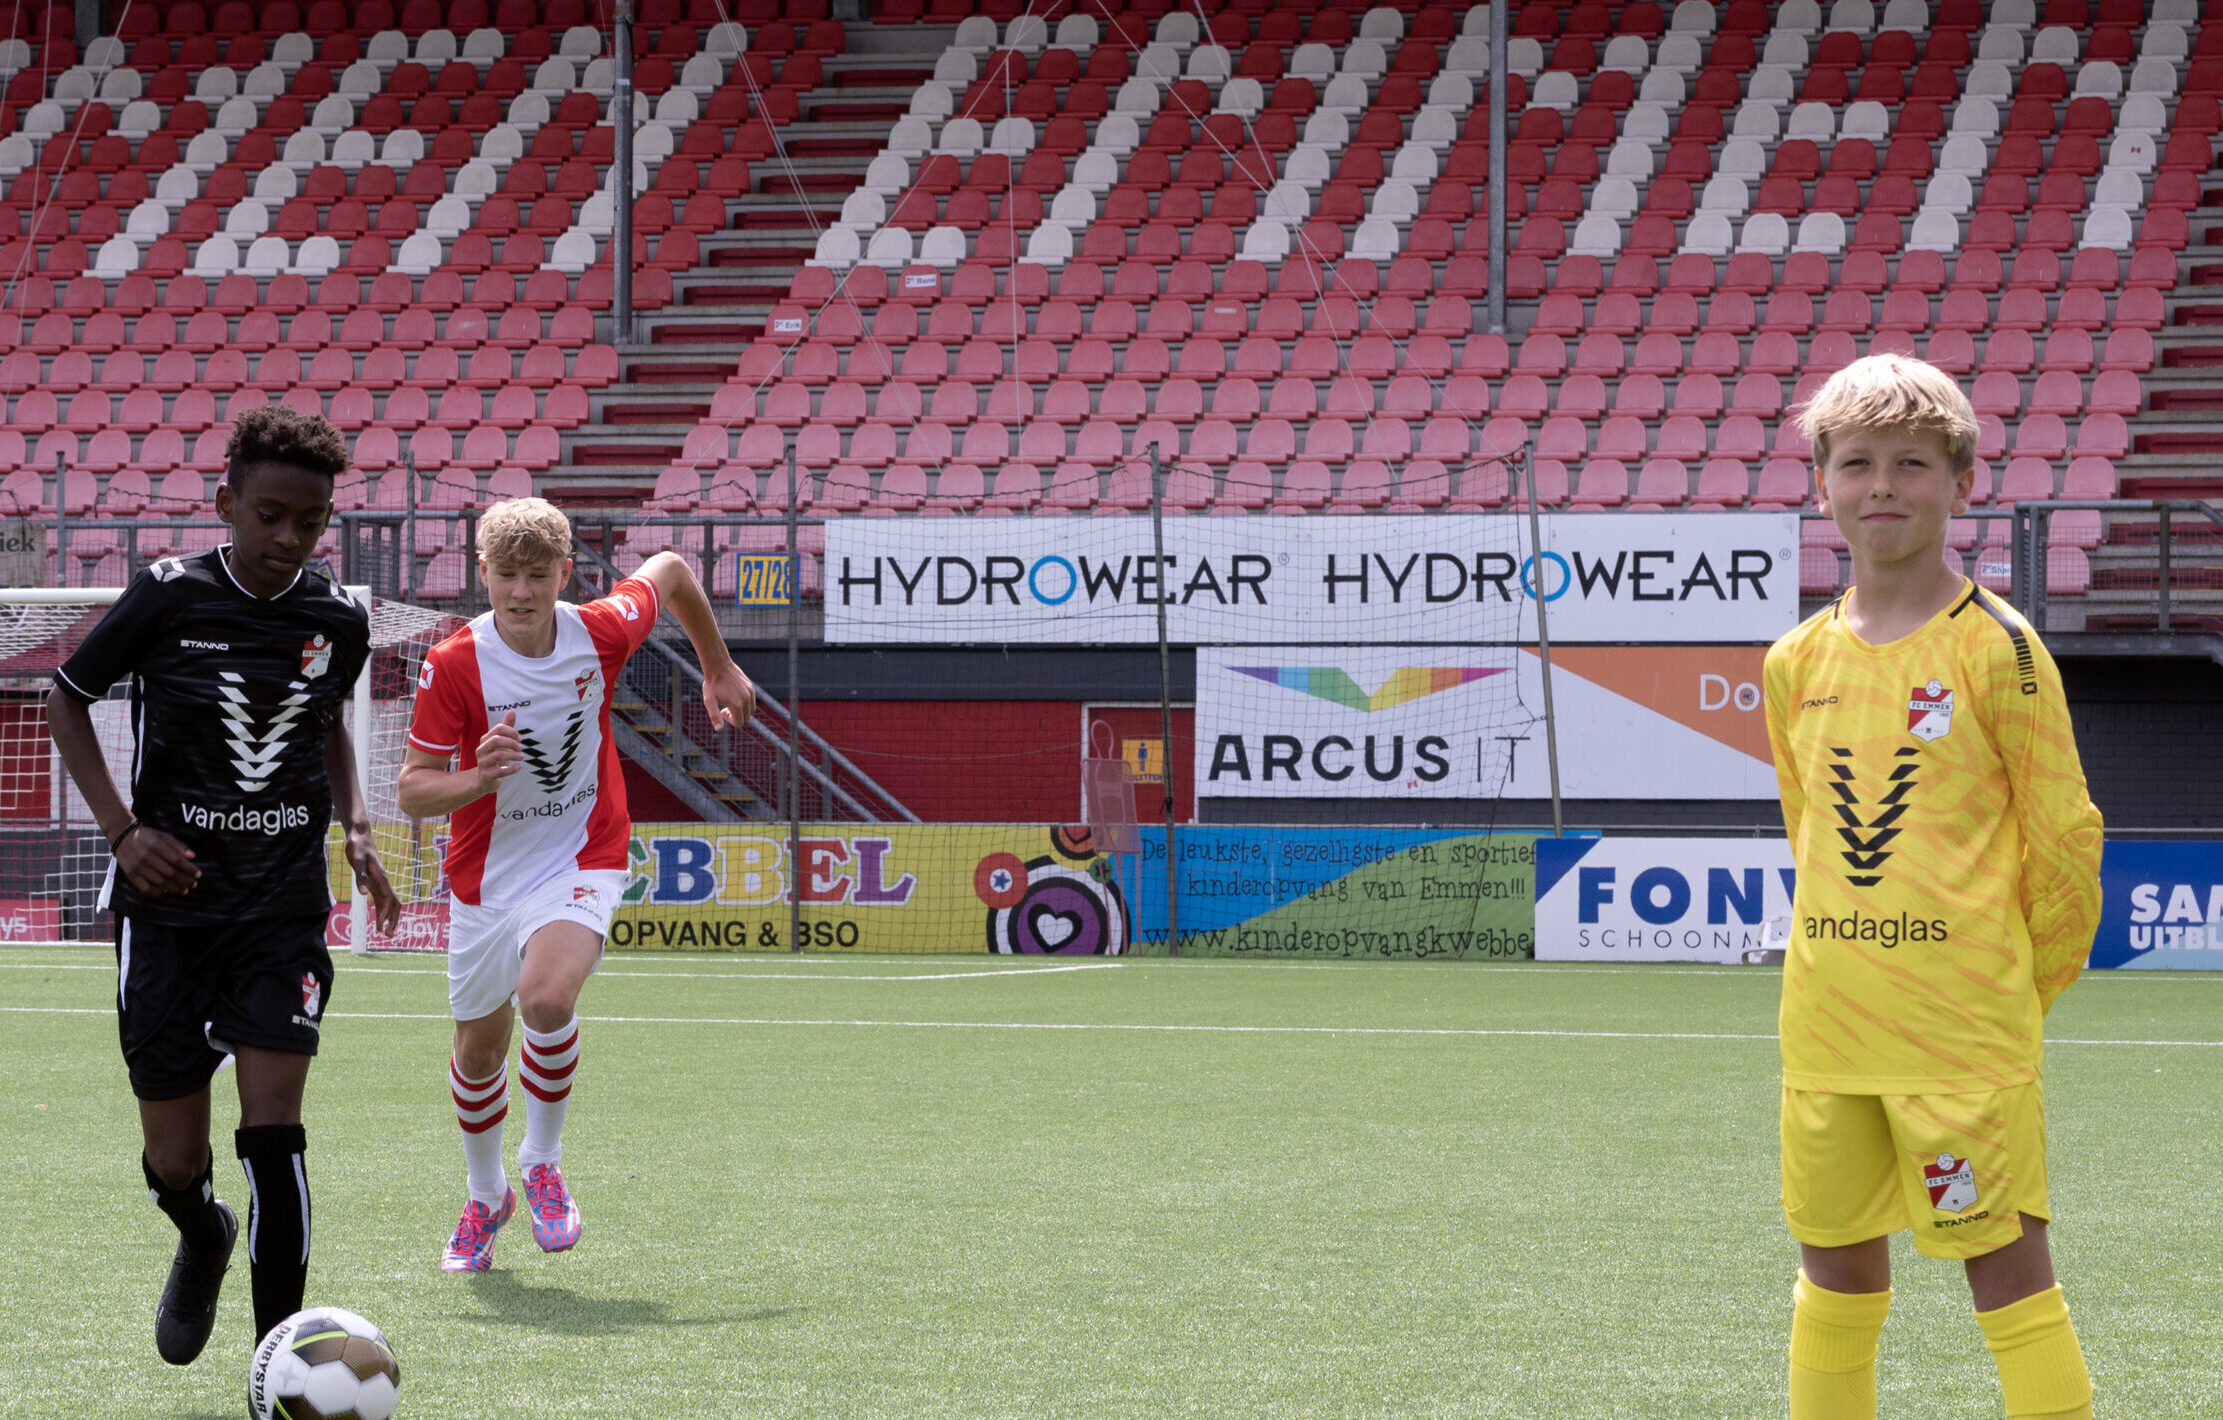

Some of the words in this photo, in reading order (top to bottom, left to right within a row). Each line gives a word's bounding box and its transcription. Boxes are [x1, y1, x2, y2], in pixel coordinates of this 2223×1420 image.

[742, 560, 790, 599] 27/28
[181, 640, 229, 650] STANNO
[488, 700, 531, 712] STANNO
[1700, 673, 1766, 712] Do
[1923, 702, 1950, 710] EMMEN
[1208, 734, 1449, 782] ARCUS
[1477, 736, 1531, 783] IT
[181, 802, 310, 836] vandaglas
[1141, 838, 1167, 861] De
[1179, 838, 1267, 865] leukste,
[1282, 839, 1395, 868] gezelligste
[1409, 844, 1437, 864] en
[1186, 871, 1349, 902] kinderopvang
[1362, 879, 1407, 902] van
[1421, 876, 1525, 901] Emmen!!!
[1578, 866, 1796, 925] FON
[606, 919, 746, 948] OPVANG
[757, 921, 780, 947] &
[1803, 910, 1948, 949] andaglas
[1933, 1210, 1989, 1229] STANNO
[255, 1323, 292, 1414] DERBYSTAR
